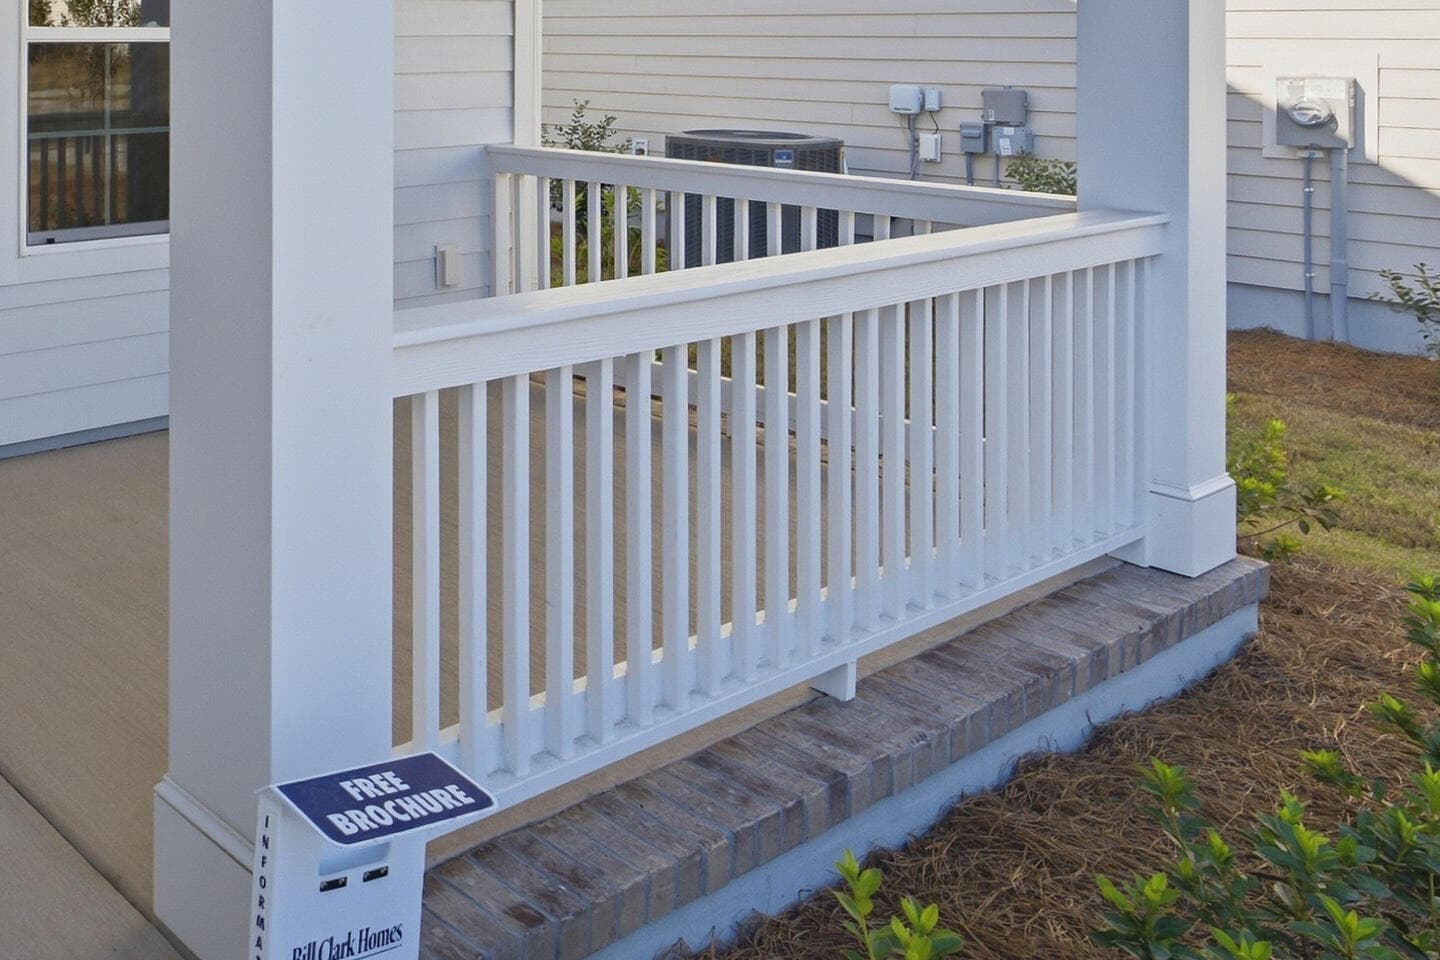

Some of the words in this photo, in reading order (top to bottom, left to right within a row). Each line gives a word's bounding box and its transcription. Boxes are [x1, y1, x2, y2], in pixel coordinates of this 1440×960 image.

[339, 771, 410, 801] FREE
[327, 785, 476, 836] BROCHURE
[318, 930, 355, 960] Clark
[357, 924, 403, 954] Homes
